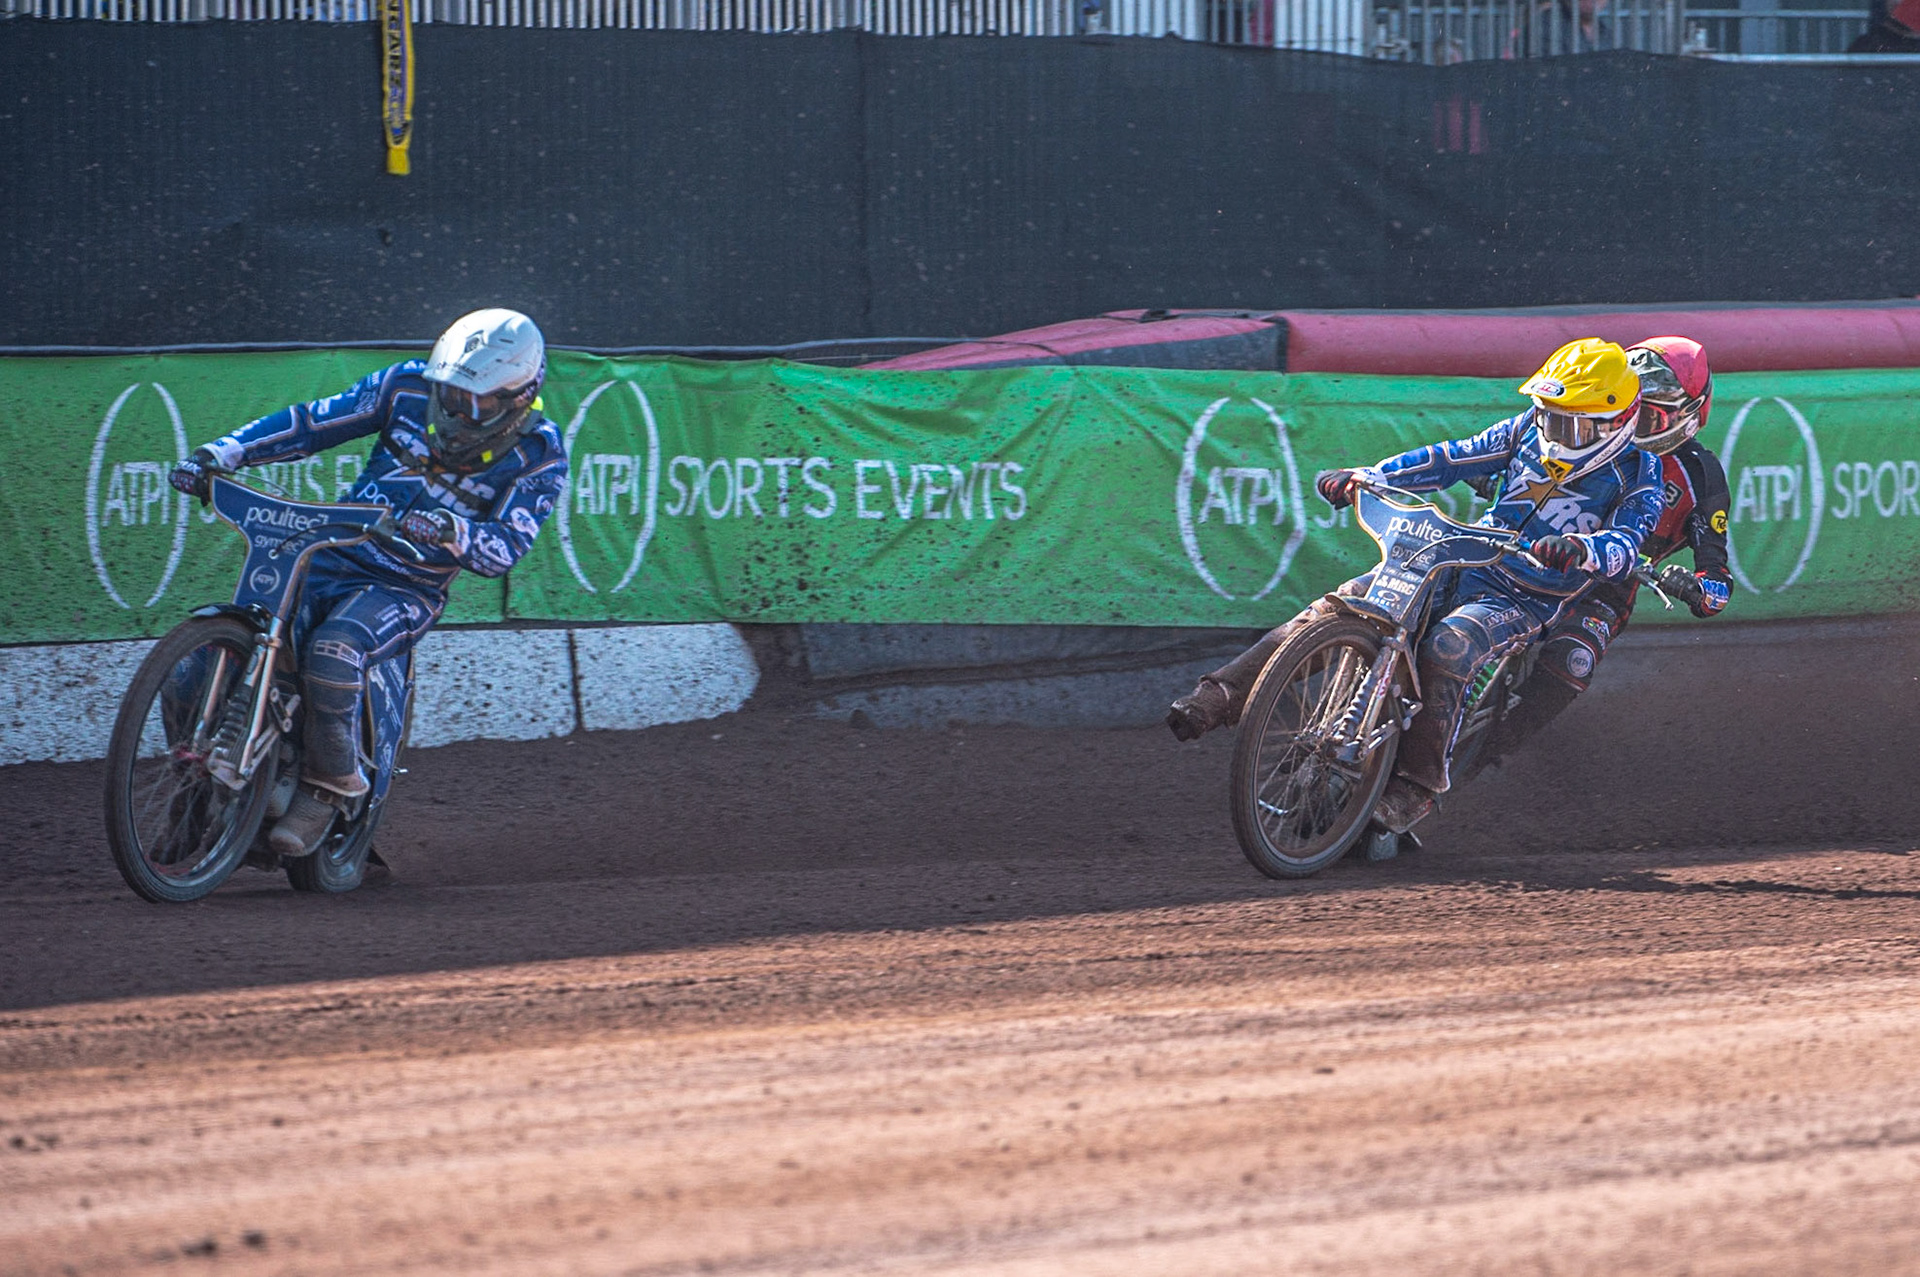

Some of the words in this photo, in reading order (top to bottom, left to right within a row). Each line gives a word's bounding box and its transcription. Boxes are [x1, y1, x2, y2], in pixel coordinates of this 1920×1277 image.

[101, 461, 170, 527] ATPI
[575, 454, 641, 516] ATPI
[664, 455, 837, 520] SPORTS
[854, 459, 1028, 521] EVENTS
[1197, 466, 1286, 526] ATPI
[1732, 464, 1803, 523] ATPI
[243, 506, 321, 535] poultec
[1385, 516, 1453, 548] poultec
